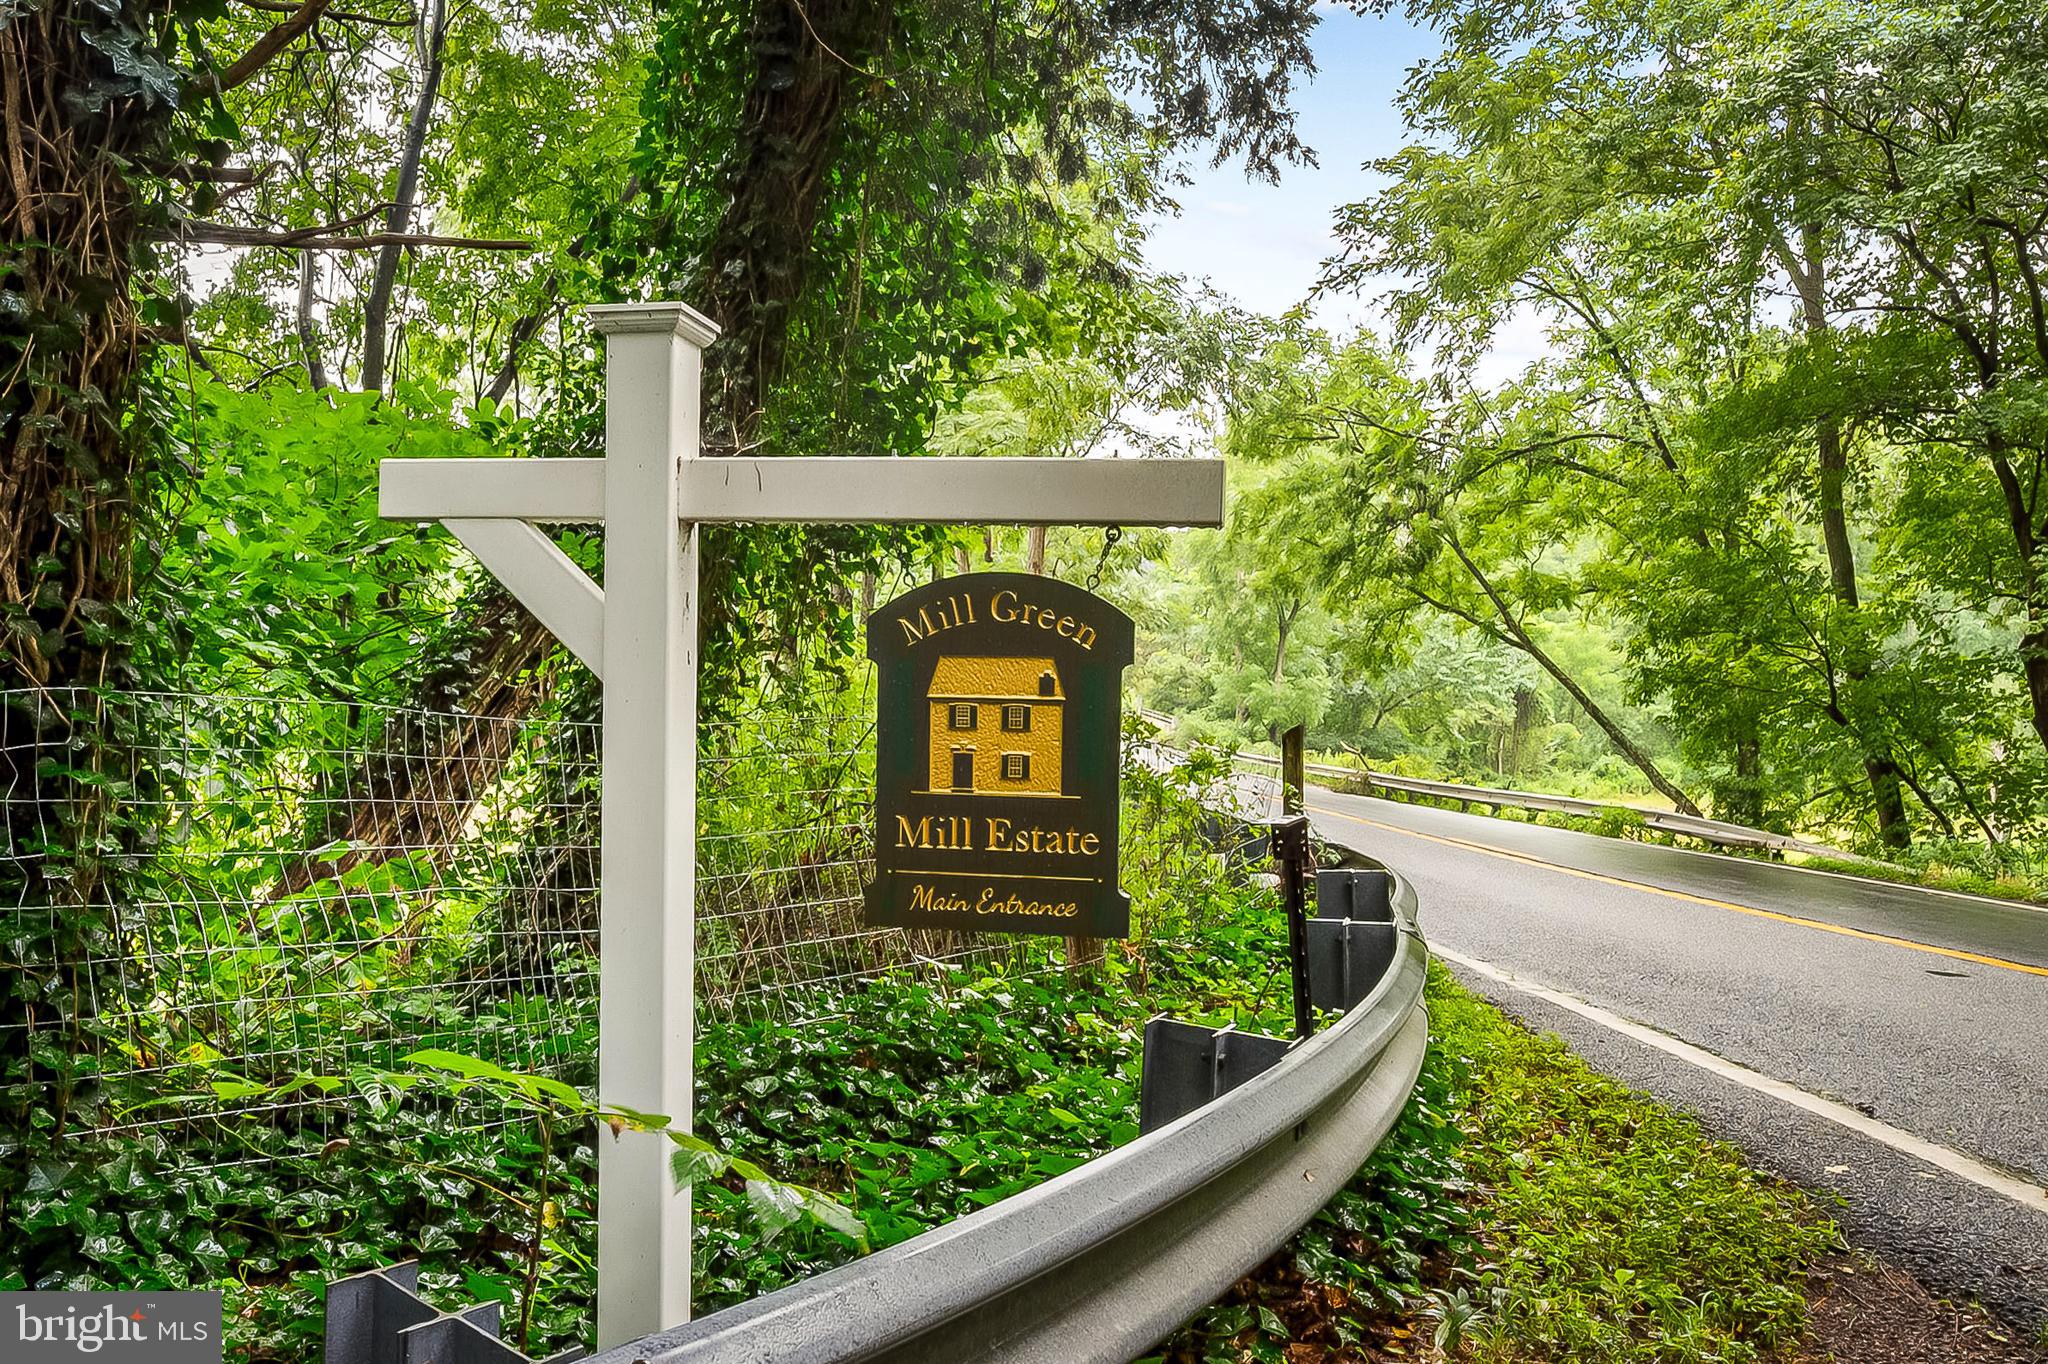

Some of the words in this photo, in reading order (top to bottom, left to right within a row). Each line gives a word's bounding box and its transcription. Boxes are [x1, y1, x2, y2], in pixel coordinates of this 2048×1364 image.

[896, 593, 976, 647] Mill
[990, 590, 1098, 651] Green
[895, 814, 974, 851] Mill
[985, 817, 1100, 856] Estate
[909, 884, 971, 912] Main
[976, 887, 1079, 917] Entrance
